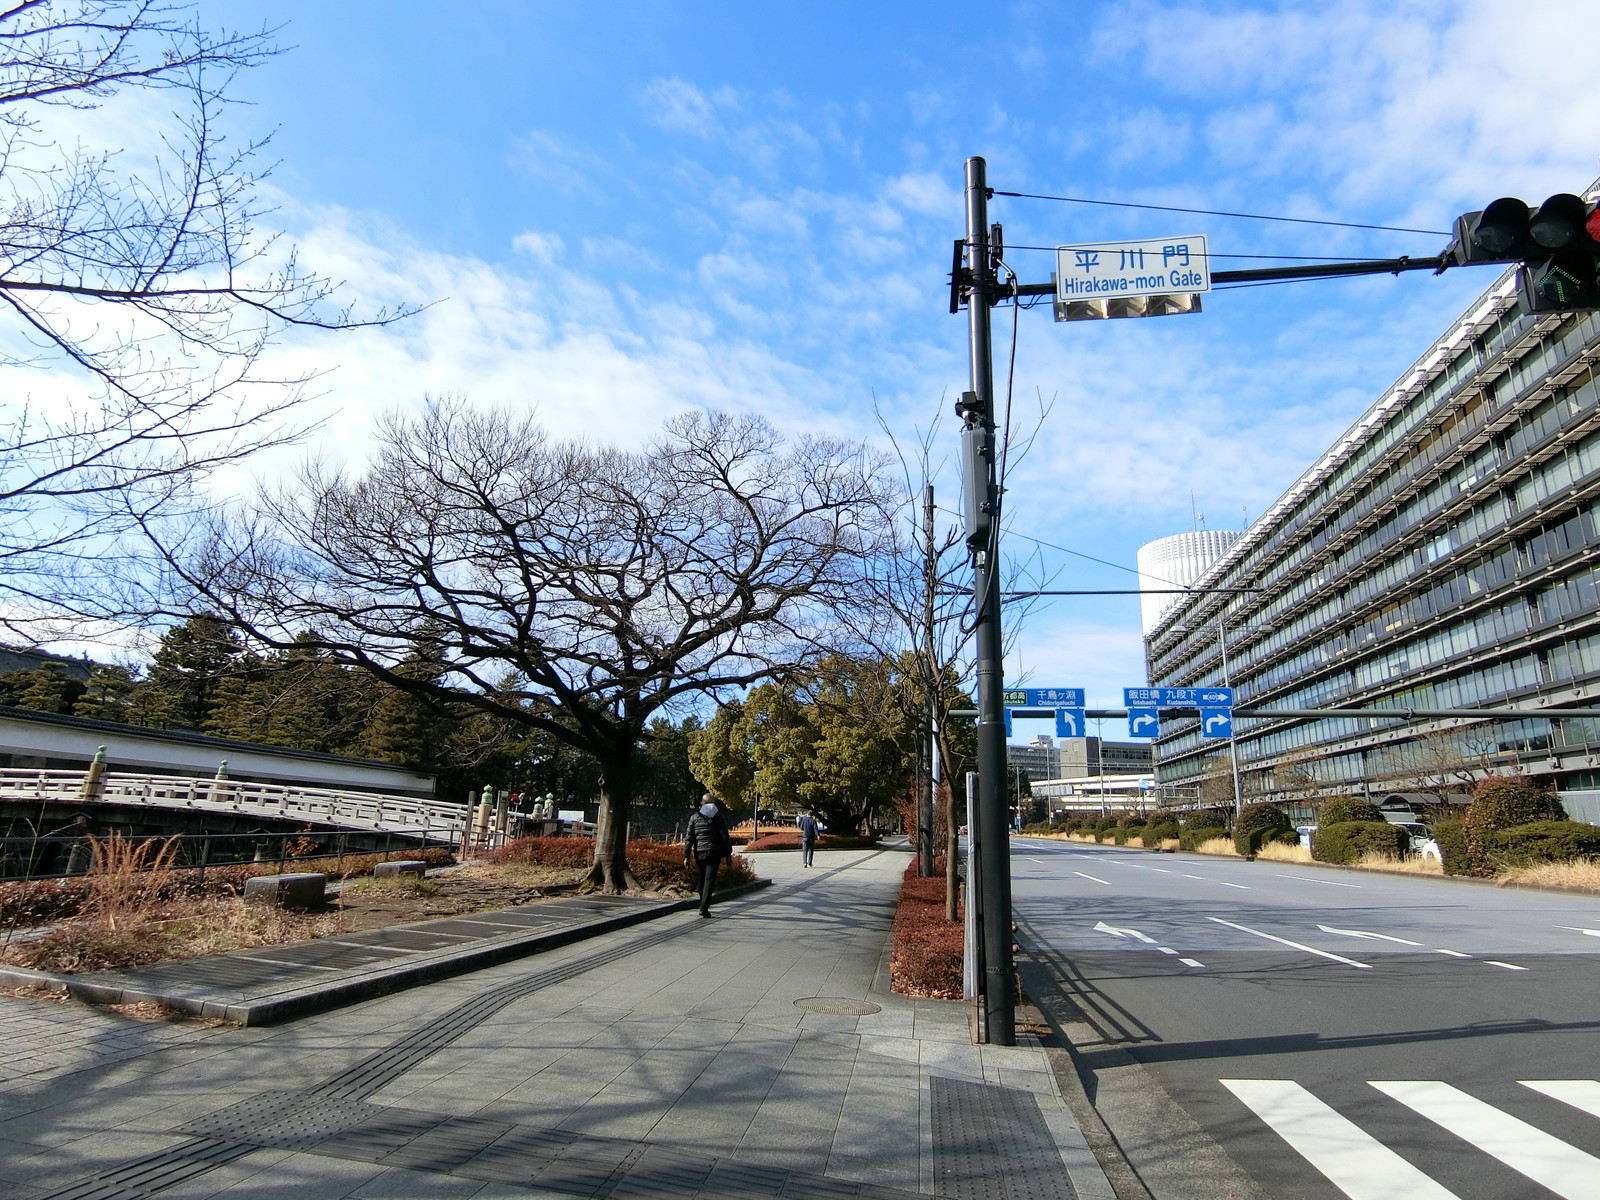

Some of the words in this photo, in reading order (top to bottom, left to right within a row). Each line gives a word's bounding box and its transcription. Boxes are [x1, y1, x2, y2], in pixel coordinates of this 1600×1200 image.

[1075, 244, 1189, 273] 平川門
[1065, 275, 1165, 294] Hirakawa-mon
[1170, 270, 1202, 287] Gate
[1128, 689, 1160, 699] 飯田橋
[1166, 689, 1197, 699] 九段下
